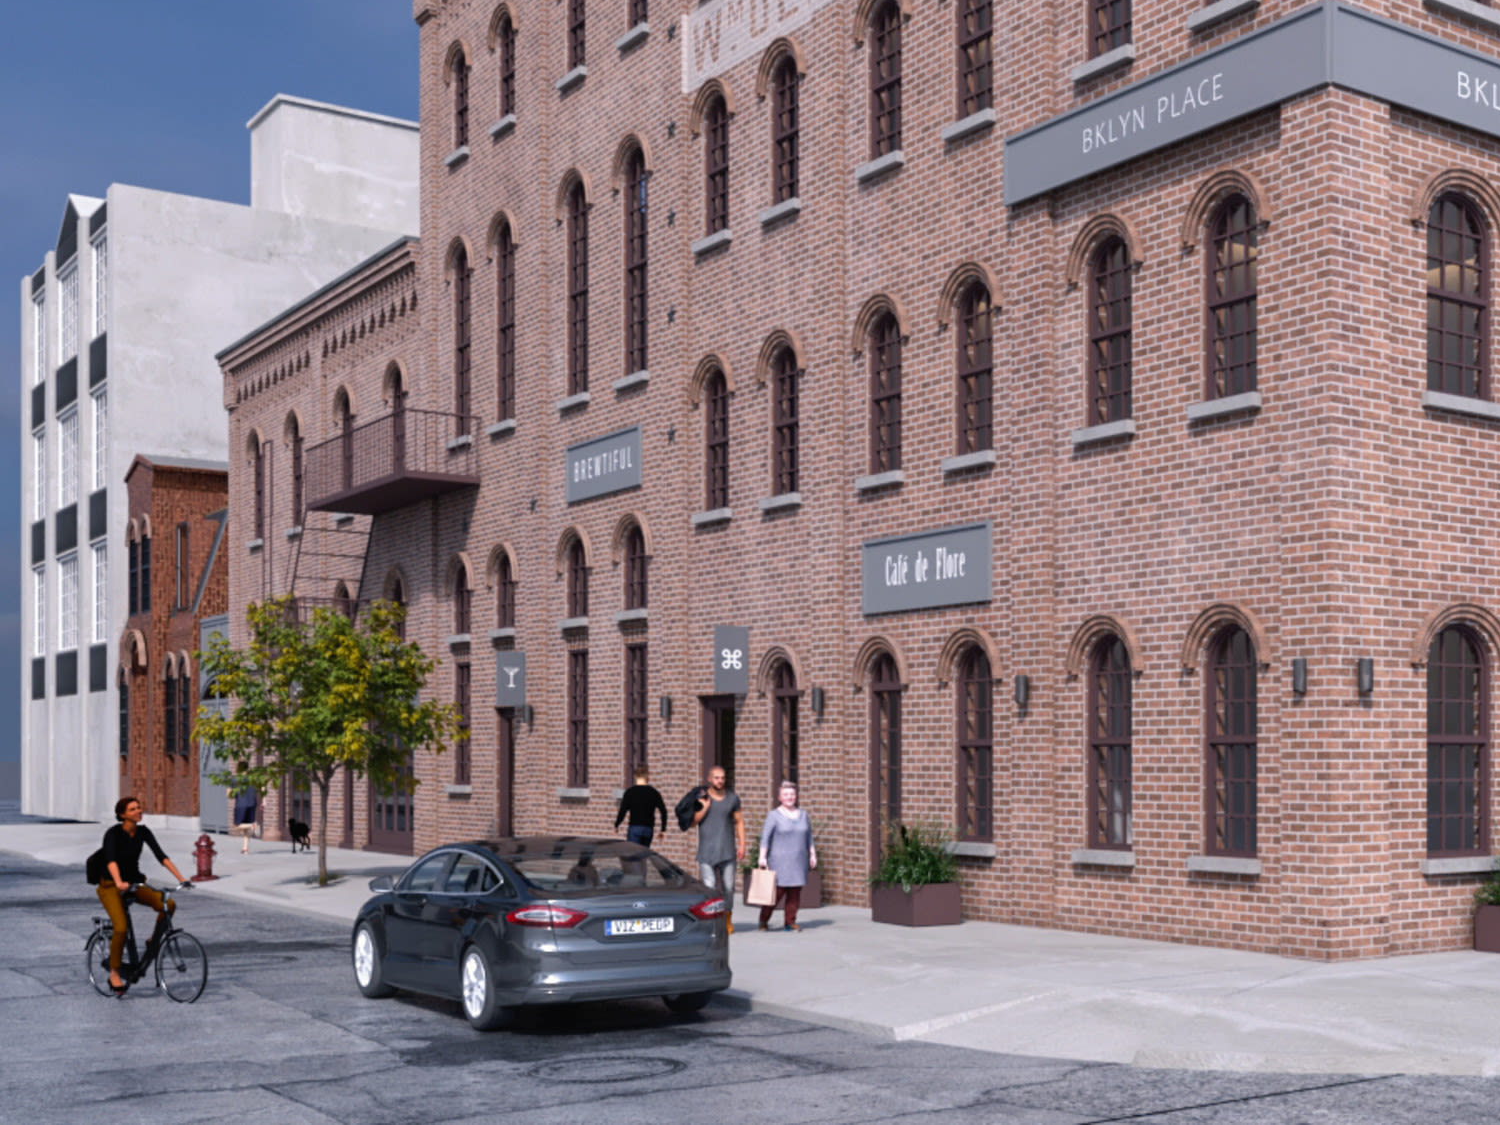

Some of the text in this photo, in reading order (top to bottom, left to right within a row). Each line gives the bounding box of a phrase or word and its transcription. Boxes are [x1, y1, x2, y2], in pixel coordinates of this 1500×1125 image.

[1082, 72, 1224, 153] BKLYN PLACE
[574, 446, 633, 483] BREWTIFUL
[885, 546, 967, 586] Café de Flore
